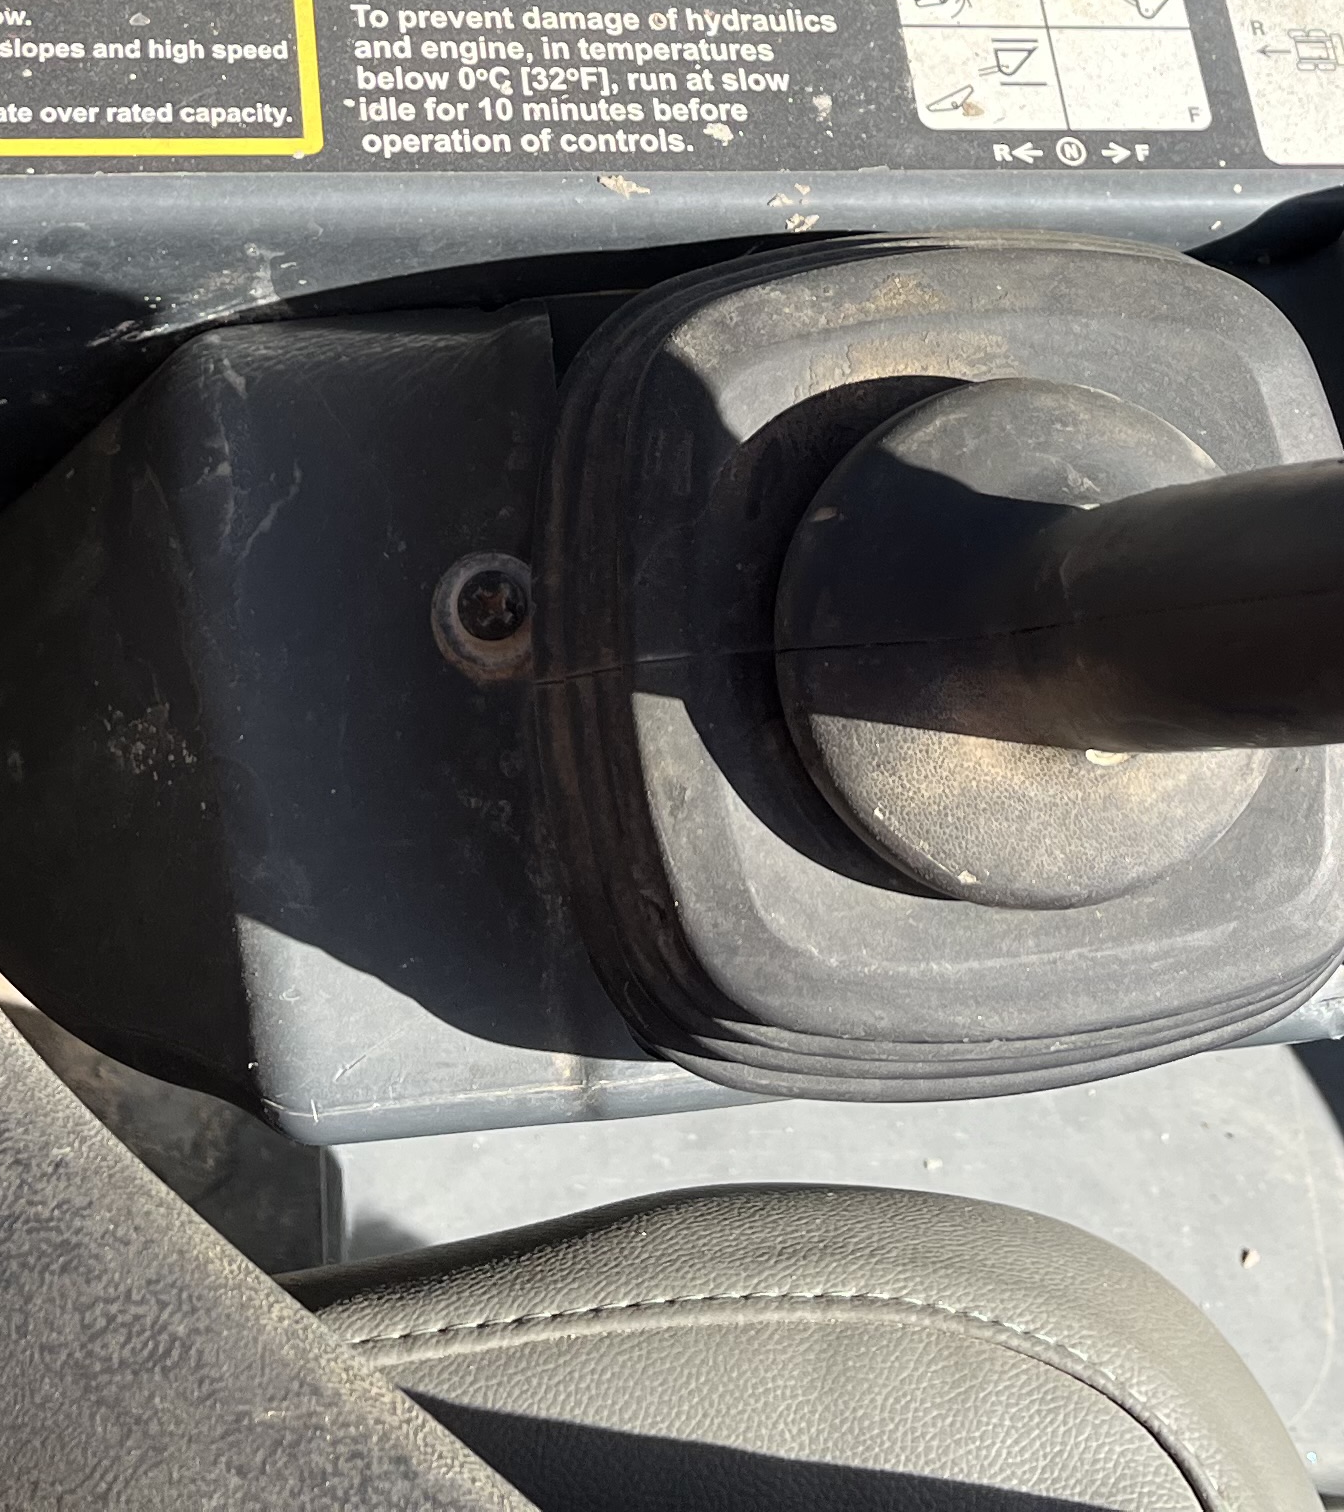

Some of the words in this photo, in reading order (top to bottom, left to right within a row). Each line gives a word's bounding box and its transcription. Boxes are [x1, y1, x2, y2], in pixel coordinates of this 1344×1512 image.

[350, 4, 389, 29] To
[399, 9, 514, 34] prevent
[522, 9, 640, 36] damage
[648, 9, 679, 31] of
[686, 9, 838, 37] hydraulics
[1250, 20, 1266, 36] R
[92, 39, 141, 58] and
[148, 40, 204, 63] high
[212, 40, 289, 63] speed
[355, 36, 411, 60] and
[421, 39, 533, 65] engine,
[542, 37, 570, 60] in
[578, 38, 774, 66] temperatures
[356, 66, 449, 90] below
[626, 71, 678, 91] run
[685, 70, 713, 91] at
[721, 69, 789, 91] slow
[40, 105, 99, 123] over
[107, 103, 173, 123] rated
[180, 103, 294, 128] capacity.
[358, 98, 415, 123] idle
[423, 98, 469, 122] for
[478, 98, 513, 122] 10
[521, 98, 644, 122] minutes
[652, 98, 748, 122] before
[1187, 106, 1201, 123] F
[361, 129, 512, 158] operation
[519, 129, 553, 153] of
[559, 130, 695, 154] controls.
[992, 143, 1014, 162] R
[1134, 143, 1150, 162] F
